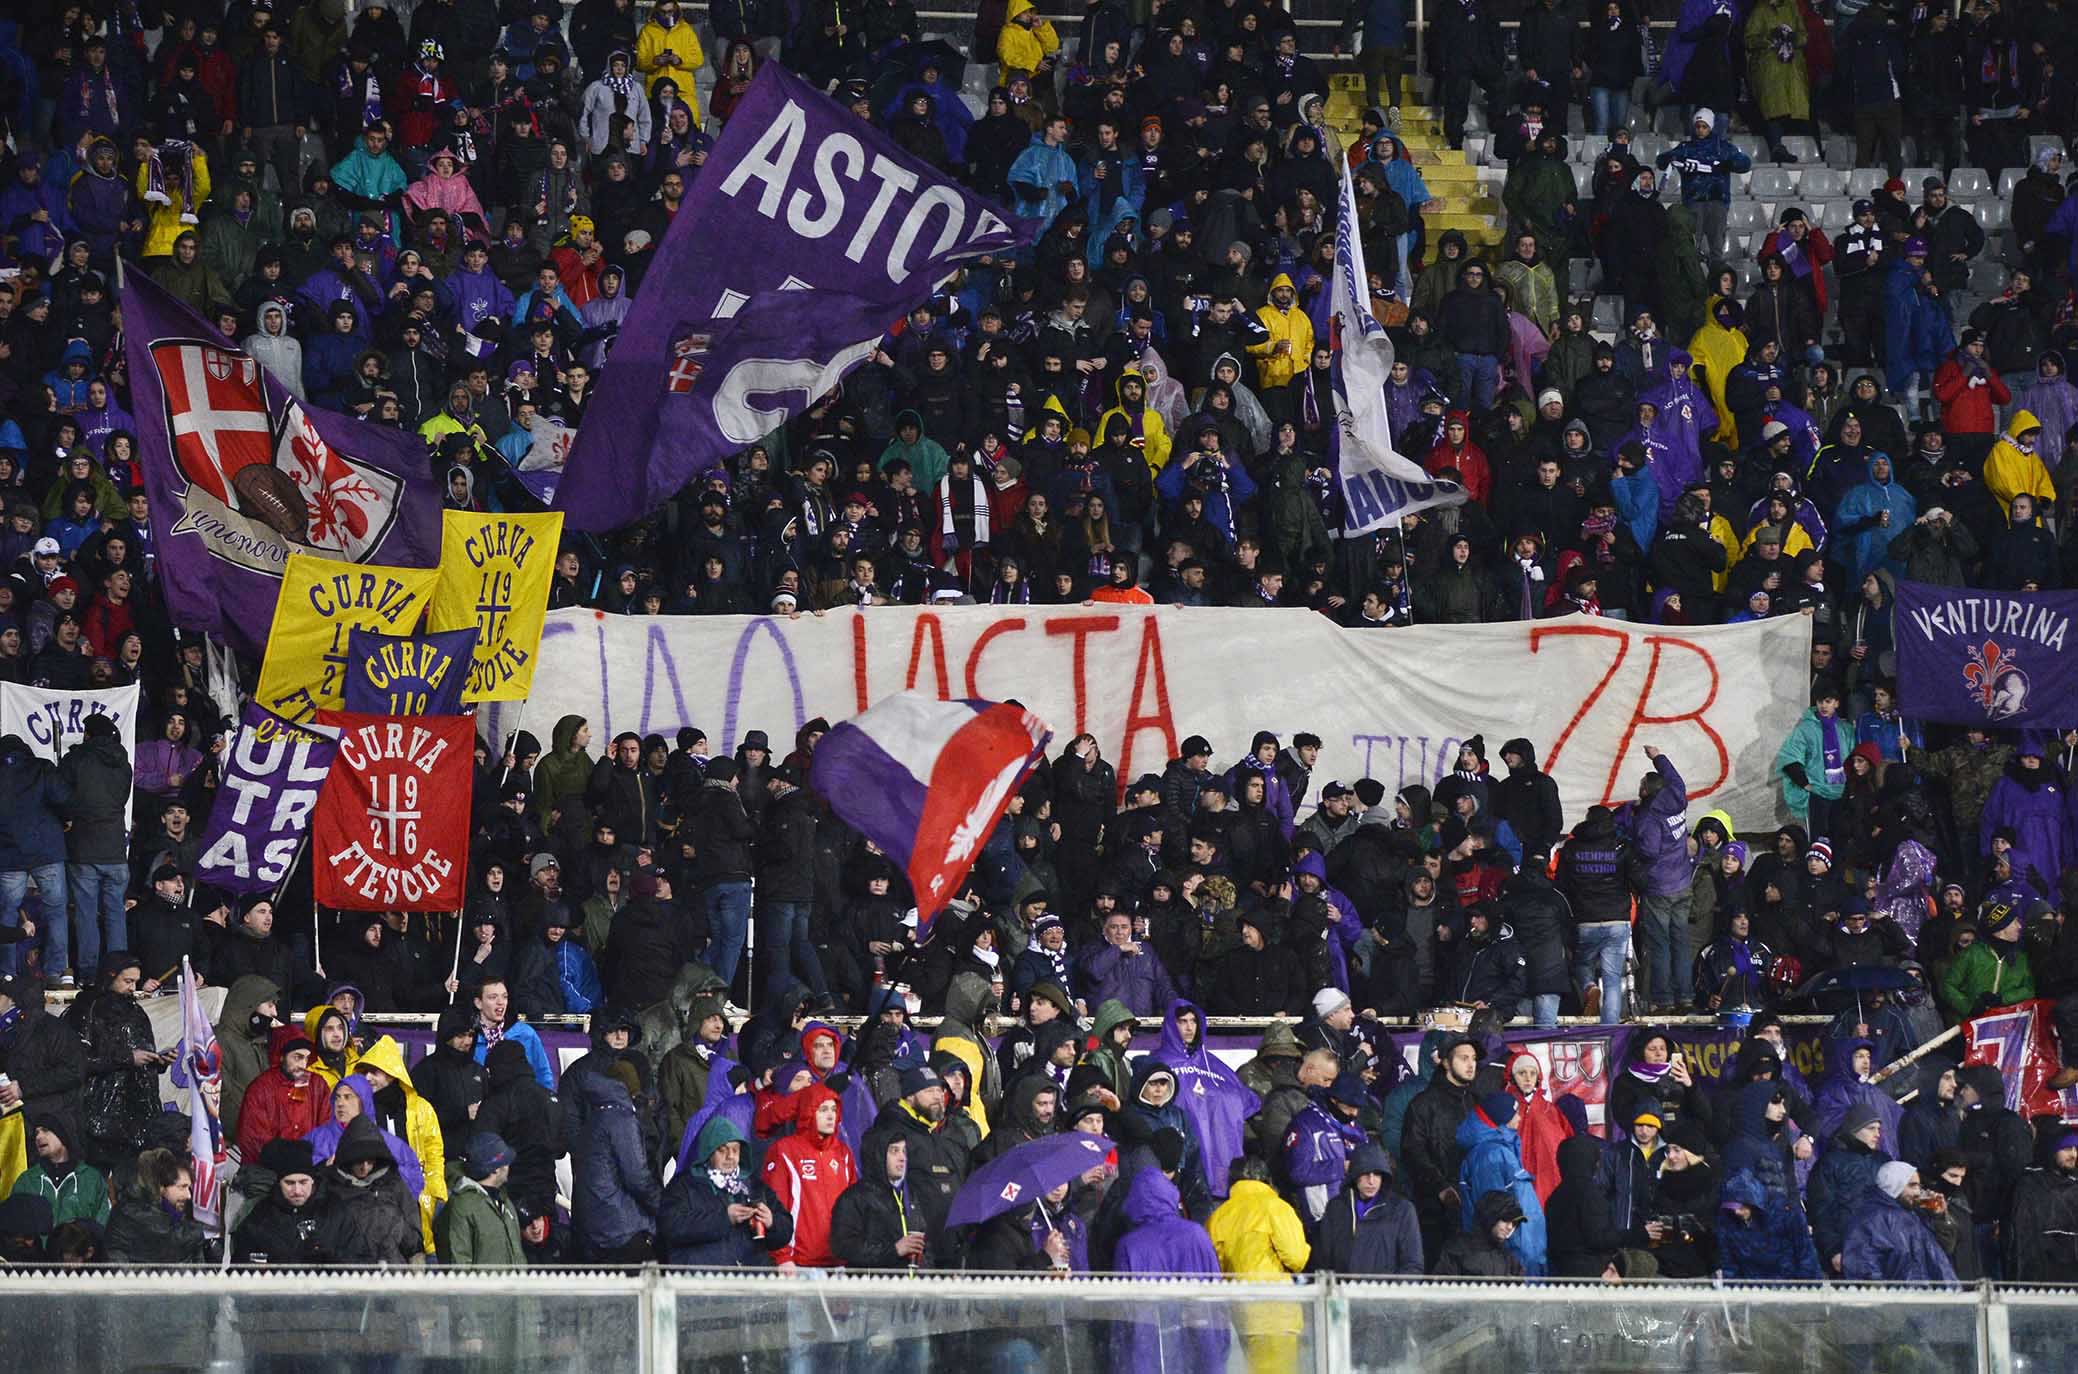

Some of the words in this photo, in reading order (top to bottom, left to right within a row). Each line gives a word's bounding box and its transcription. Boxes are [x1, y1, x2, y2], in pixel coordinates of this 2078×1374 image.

[465, 522, 535, 569] CURVA
[309, 574, 416, 624] CURVA
[1911, 599, 2069, 652] VENTURINA
[365, 641, 451, 690] CURVA
[27, 699, 120, 745] CUR
[1530, 625, 1729, 807] 7B
[234, 725, 329, 781] UL
[339, 722, 448, 774] CURVA
[226, 774, 317, 831] TR
[198, 831, 297, 882] AS
[328, 840, 452, 904] FIESOLE
